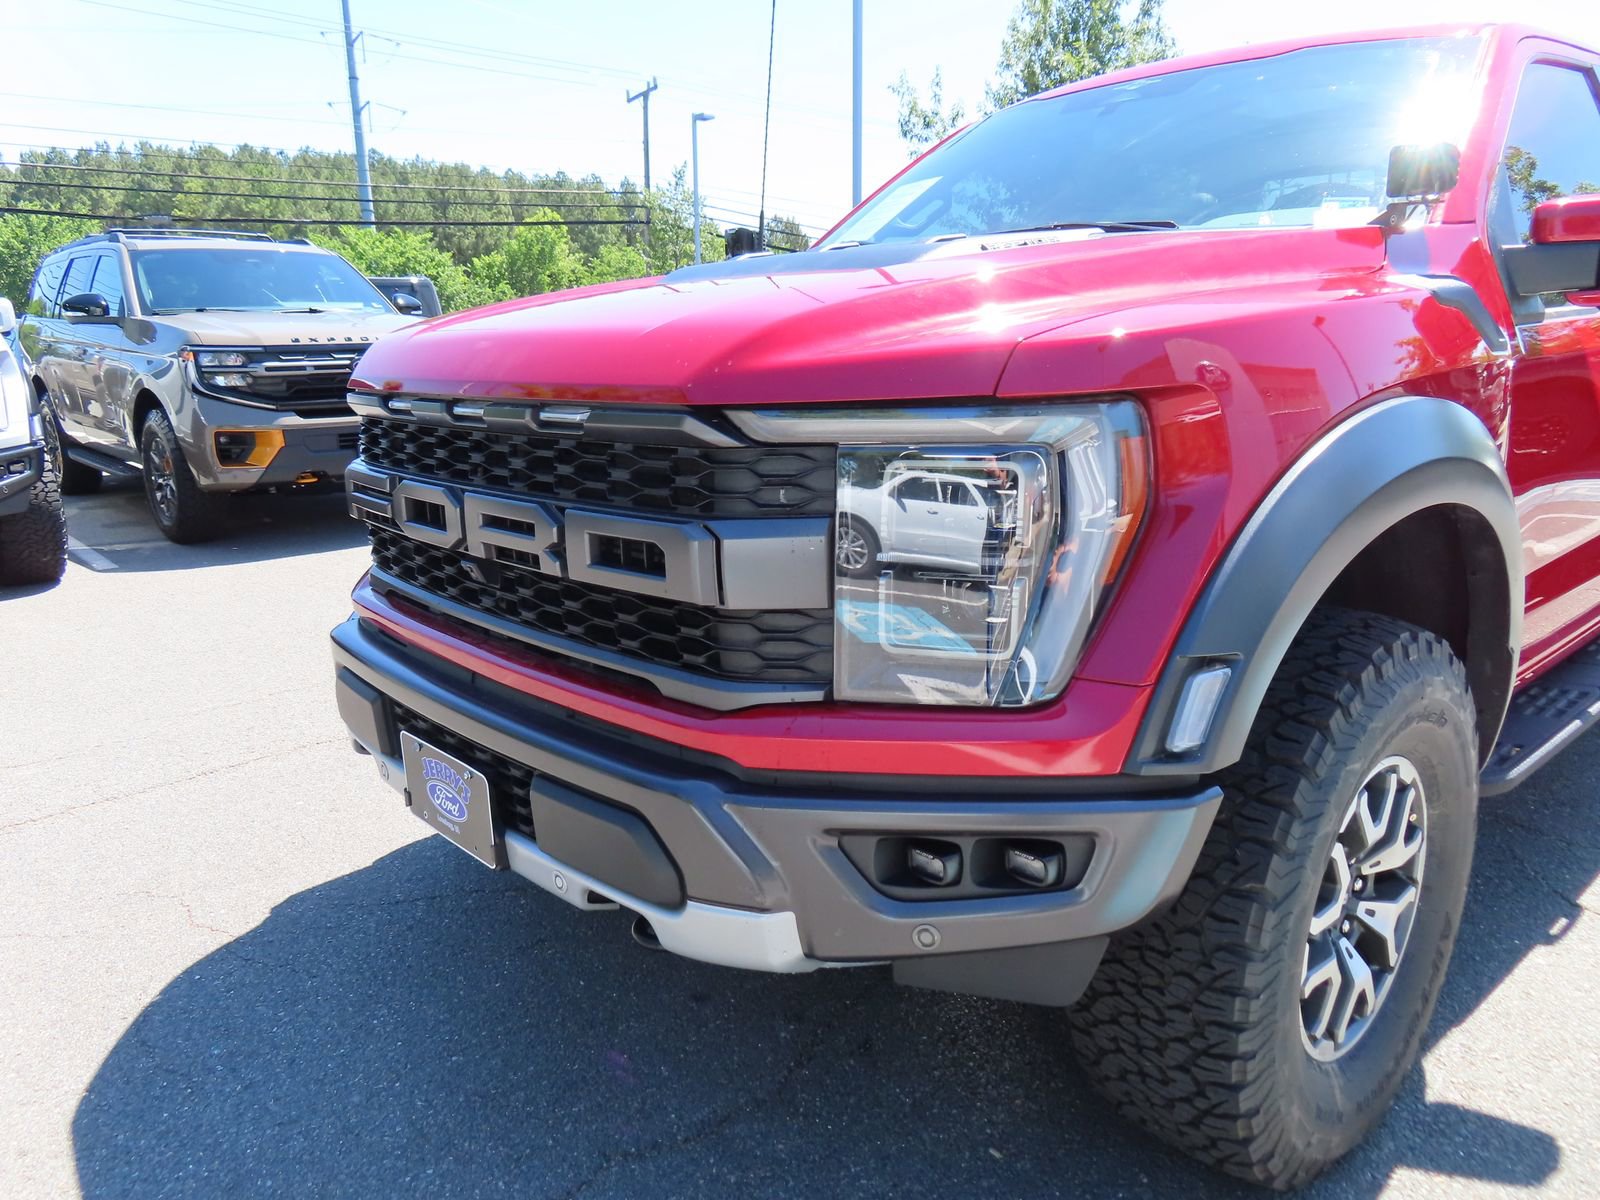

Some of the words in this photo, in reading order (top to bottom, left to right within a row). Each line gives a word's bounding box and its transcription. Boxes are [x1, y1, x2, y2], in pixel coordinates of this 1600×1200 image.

[345, 463, 717, 607] FORD
[421, 757, 471, 804] JERRY'S
[434, 786, 460, 817] Ford
